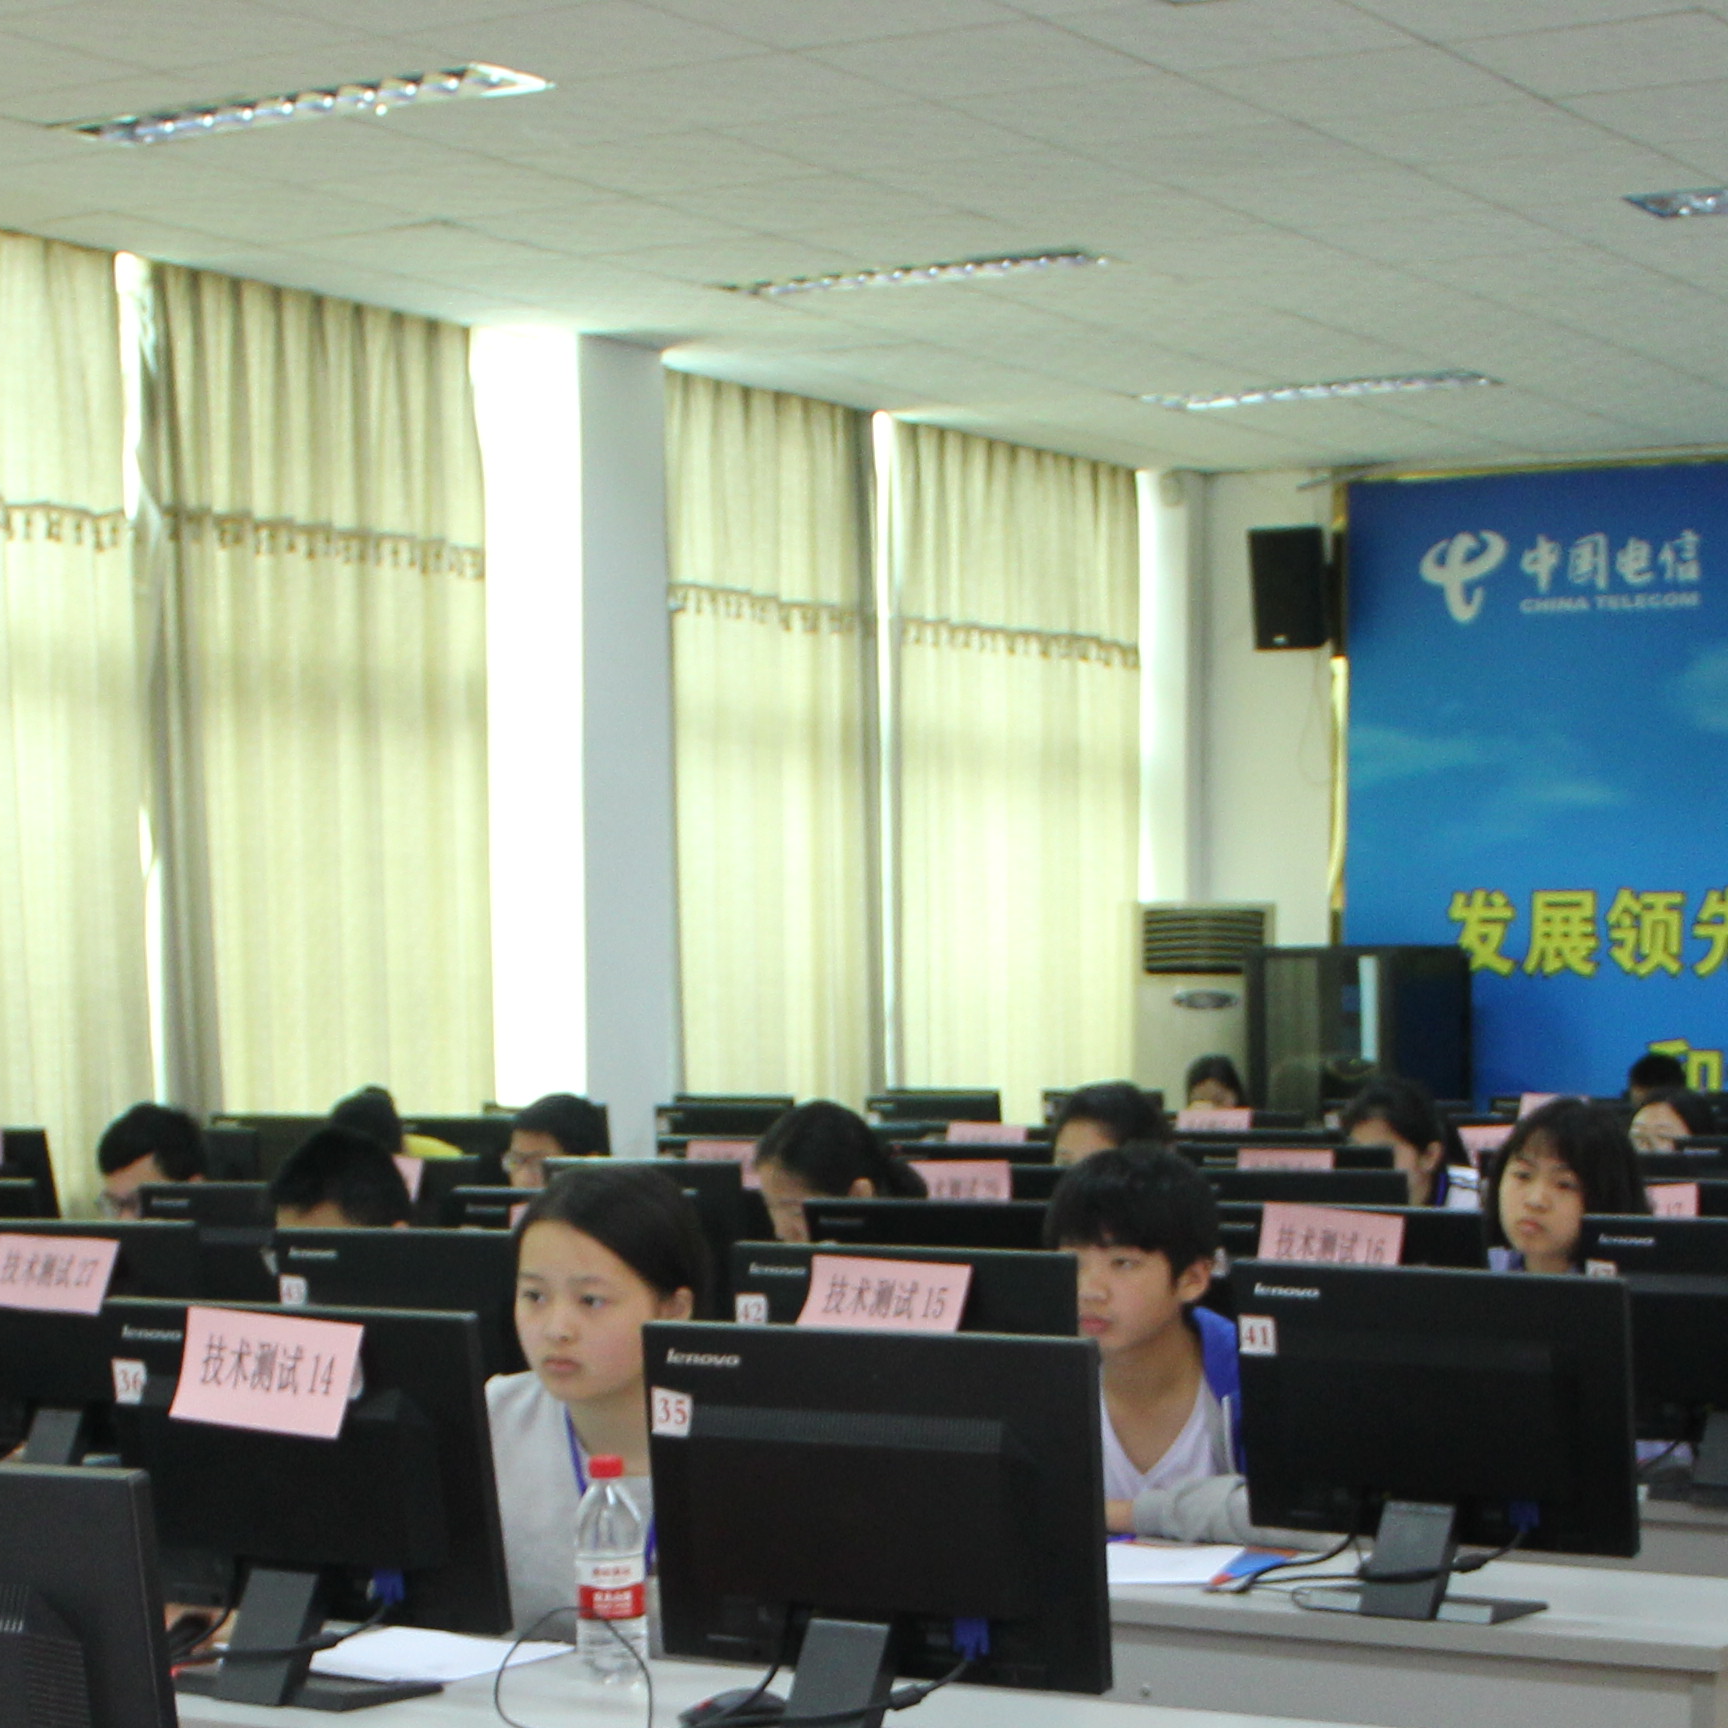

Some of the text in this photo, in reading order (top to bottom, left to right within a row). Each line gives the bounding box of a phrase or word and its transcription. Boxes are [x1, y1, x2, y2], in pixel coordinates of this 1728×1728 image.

[1520, 530, 1700, 591] 中国电信
[1520, 592, 1700, 613] CHINA TELECOM
[823, 1273, 949, 1321] 技术测试15
[1245, 1326, 1270, 1346] 41
[200, 1333, 337, 1396] 技术测试14
[666, 1348, 741, 1369] lenovo
[657, 1396, 688, 1425] 35
